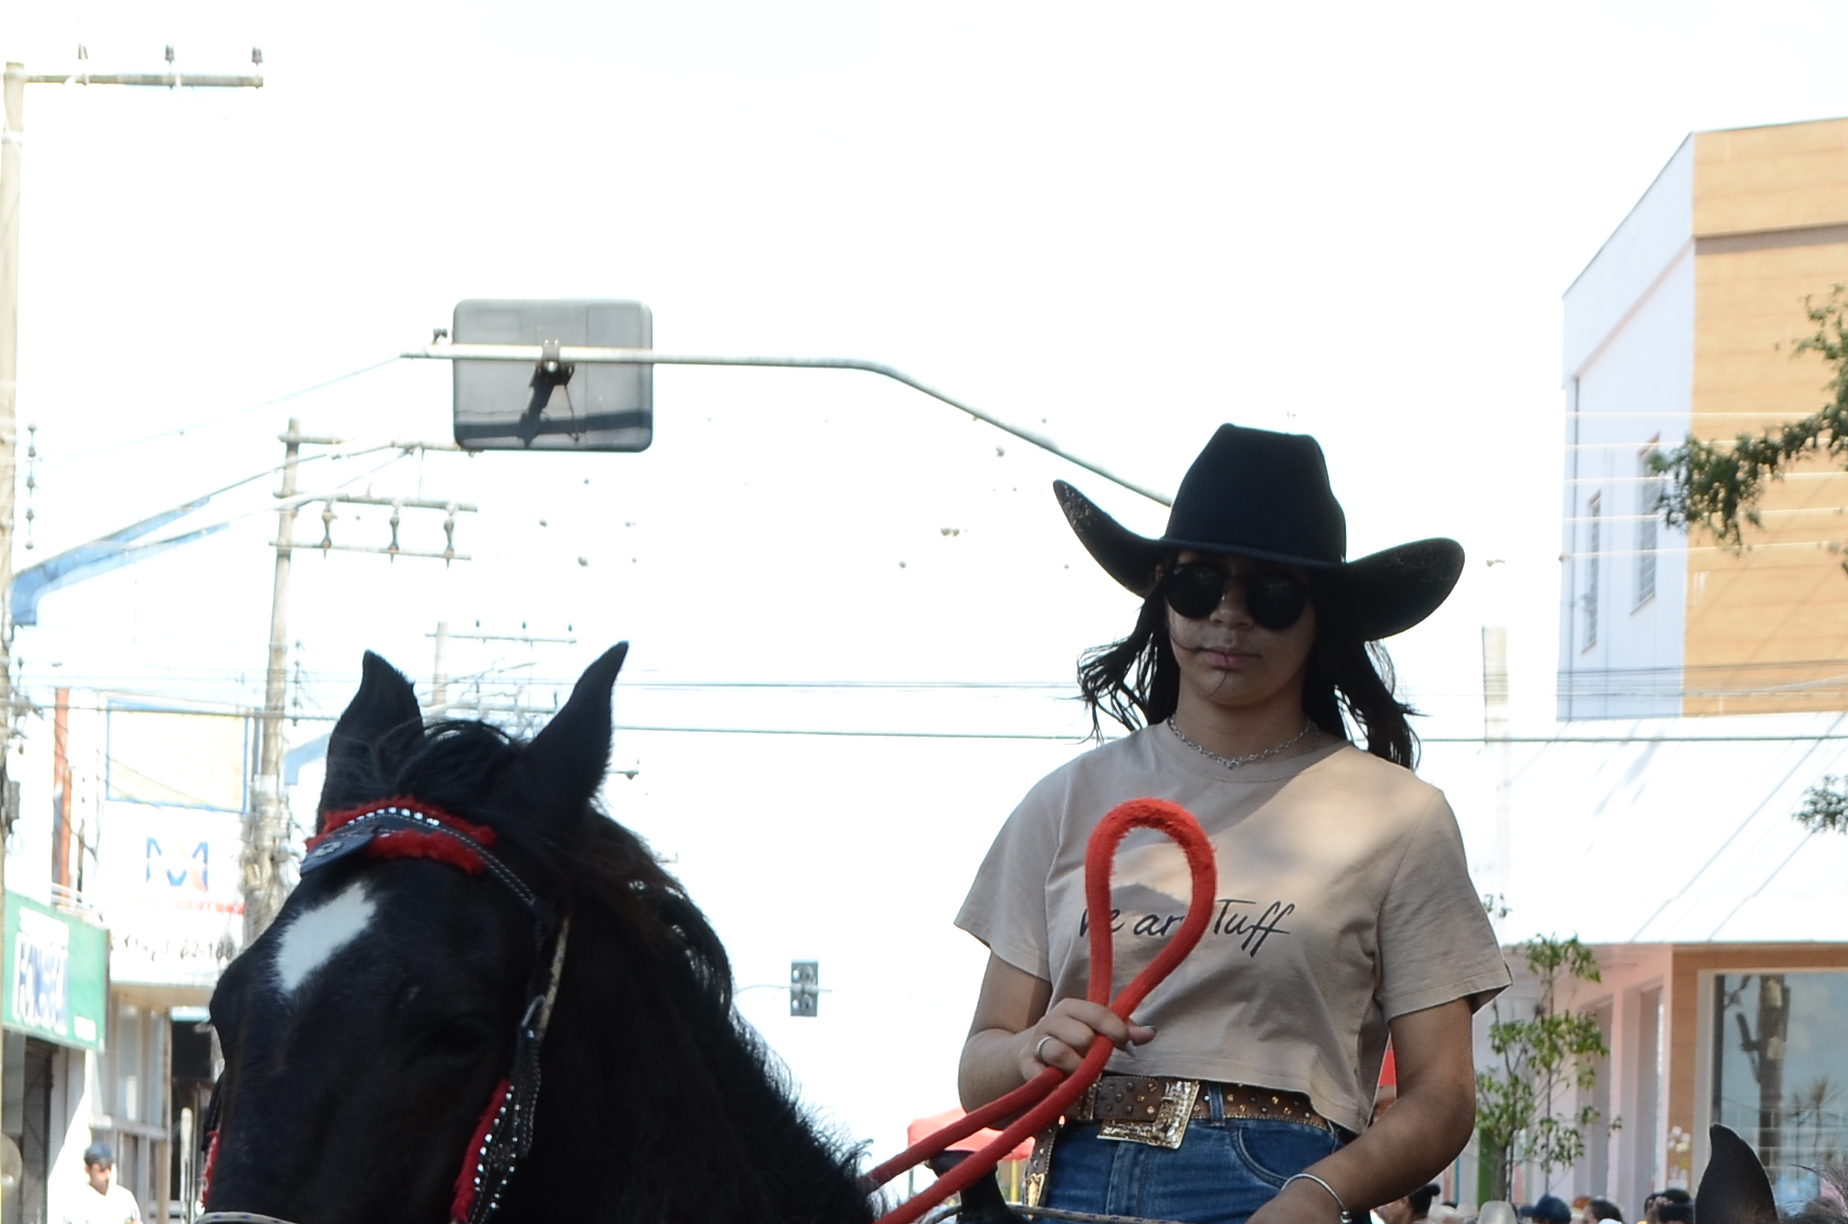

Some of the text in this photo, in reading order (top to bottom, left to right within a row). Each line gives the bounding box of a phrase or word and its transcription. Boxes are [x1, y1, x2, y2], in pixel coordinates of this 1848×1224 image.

[1079, 898, 1295, 957] e ar Tuff
